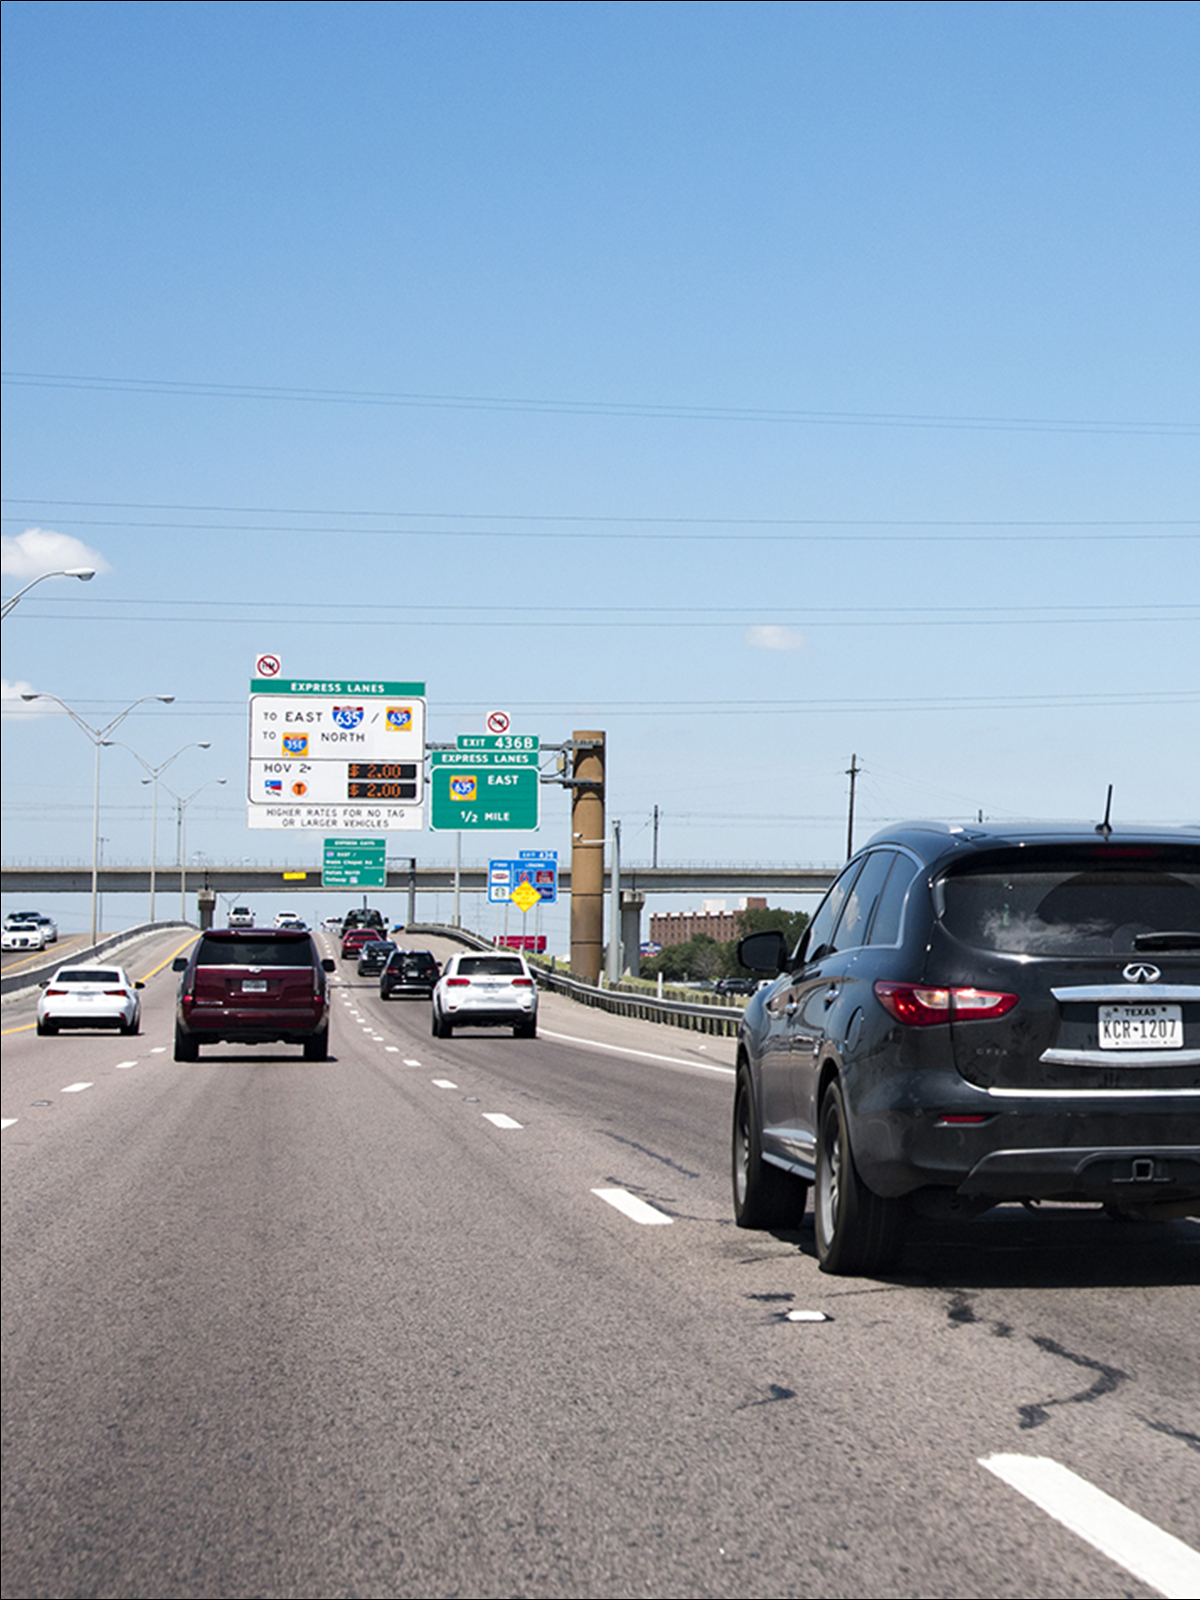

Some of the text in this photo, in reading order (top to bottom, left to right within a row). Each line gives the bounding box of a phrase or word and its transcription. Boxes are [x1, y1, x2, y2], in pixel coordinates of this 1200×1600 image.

[291, 682, 385, 693] EXPRESS LANES
[263, 711, 278, 721] TO
[284, 711, 323, 723] EAST
[335, 712, 361, 725] 635
[390, 712, 408, 723] 635
[262, 731, 277, 740] TO
[321, 732, 366, 743] NORTH
[462, 737, 533, 749] EXIT 436B
[441, 754, 529, 764] EXPRESS LANES
[263, 763, 292, 774] HOV
[367, 764, 401, 778] 2.00
[455, 775, 519, 792] 635 EAST
[367, 783, 401, 797] 2.00
[266, 808, 406, 818] HIGHER RATES FOR NO TAG
[484, 812, 510, 822] MILE
[282, 819, 390, 828] OR LARGER VEHICLES
[1124, 1008, 1157, 1017] TEXAS
